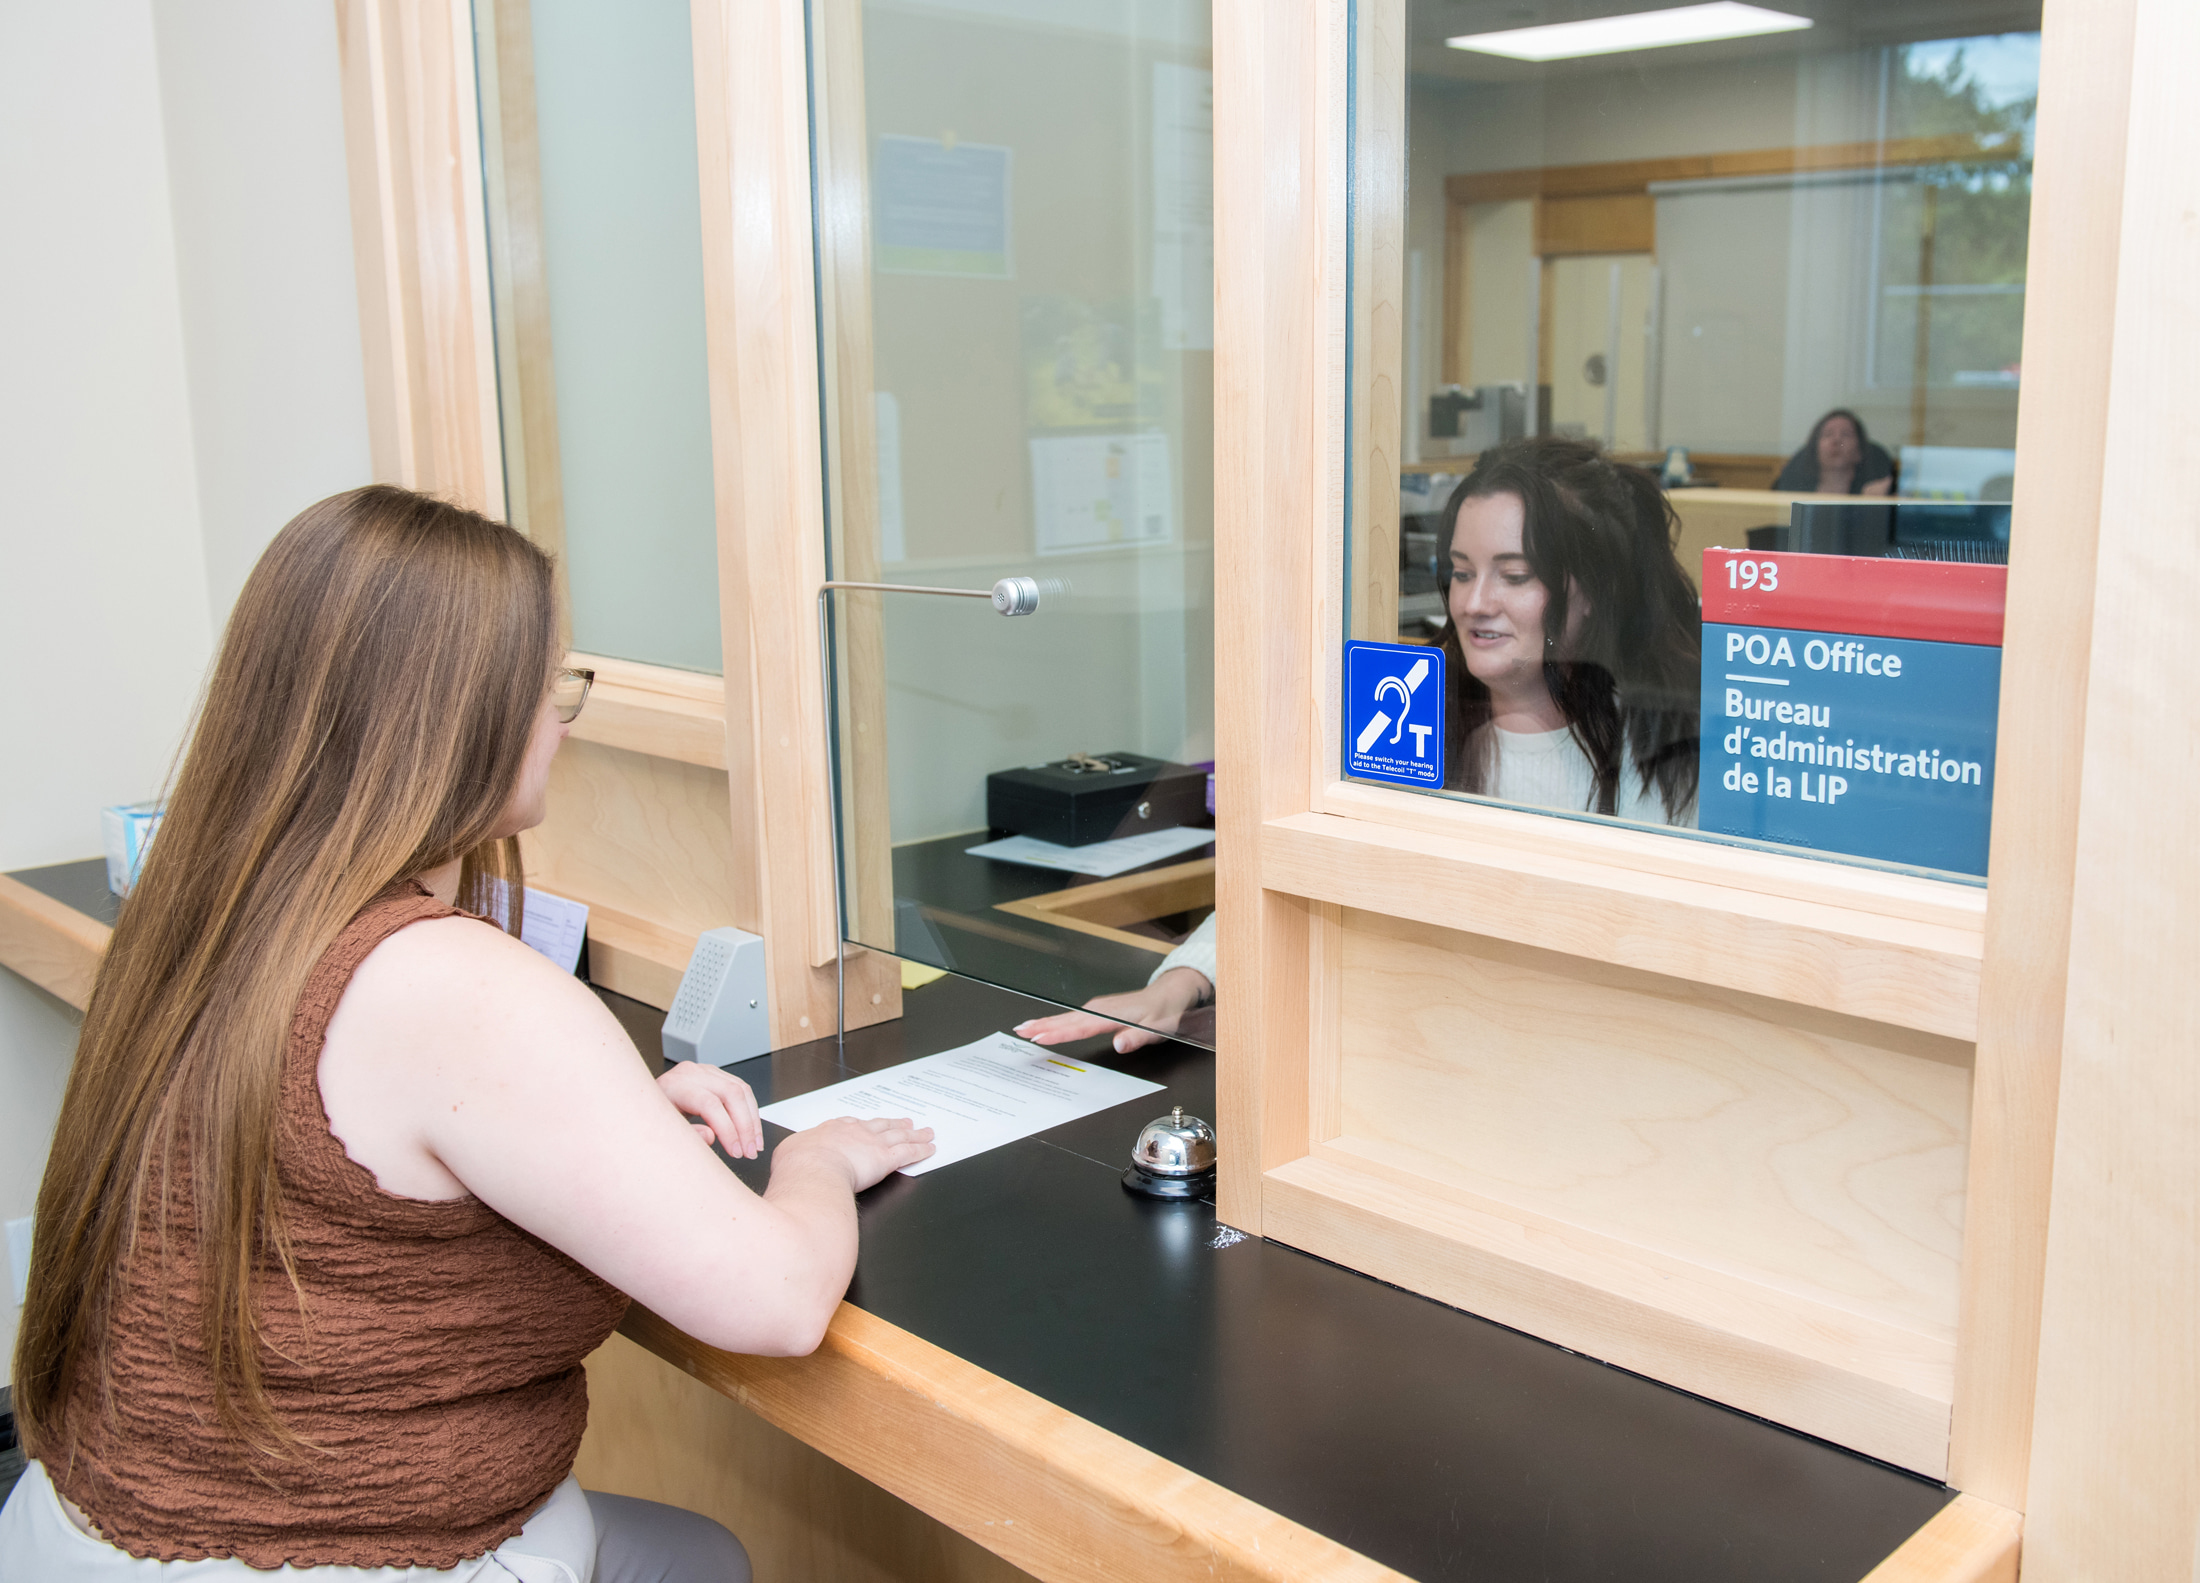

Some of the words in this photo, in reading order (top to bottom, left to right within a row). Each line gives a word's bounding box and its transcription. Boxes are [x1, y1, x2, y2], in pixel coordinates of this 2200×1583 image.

[1724, 559, 1779, 592] 193
[1726, 632, 1796, 668] POA
[1803, 639, 1902, 678] Office
[1725, 687, 1831, 728] Bureau
[1408, 723, 1433, 758] T
[1723, 725, 1982, 786] d'administration
[1354, 752, 1373, 761] Please
[1374, 755, 1394, 764] switch
[1395, 758, 1409, 767] your
[1410, 760, 1434, 771] hearing
[1371, 762, 1381, 770] the
[1382, 764, 1405, 773] Telecoil
[1418, 770, 1435, 778] mode
[1723, 762, 1759, 794] de
[1766, 766, 1791, 799] la
[1800, 771, 1848, 805] LIP
